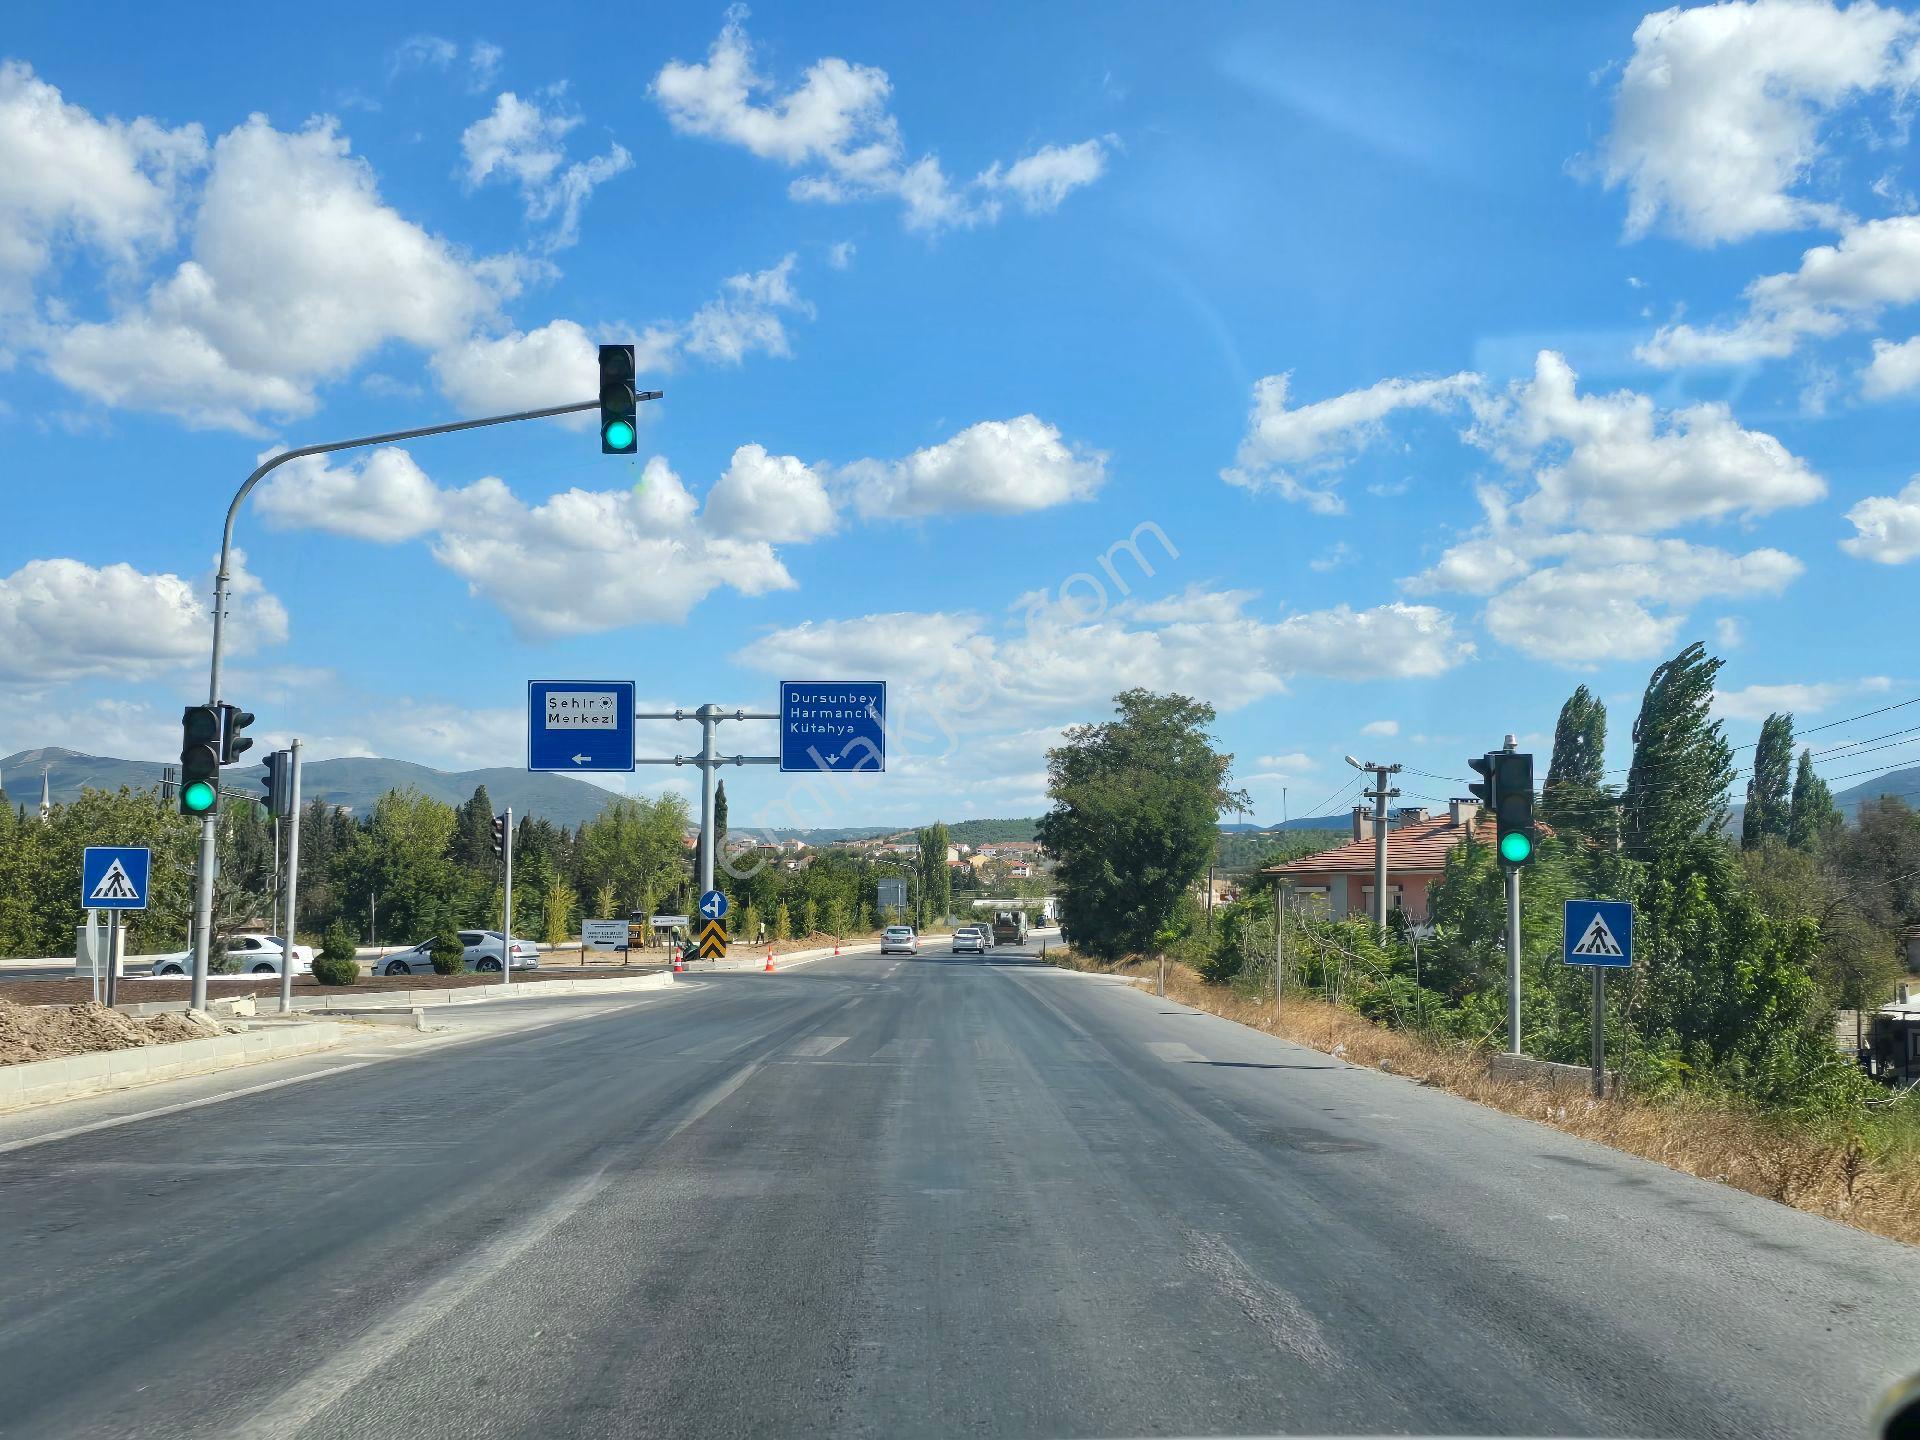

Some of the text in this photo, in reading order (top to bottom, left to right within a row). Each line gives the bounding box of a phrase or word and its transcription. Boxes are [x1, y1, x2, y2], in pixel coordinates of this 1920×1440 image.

[549, 697, 595, 709] Şehir
[791, 692, 877, 706] Dursunbey
[548, 713, 614, 724] Merkezi
[791, 707, 876, 718] Harmancık
[790, 722, 854, 736] Kütahya
